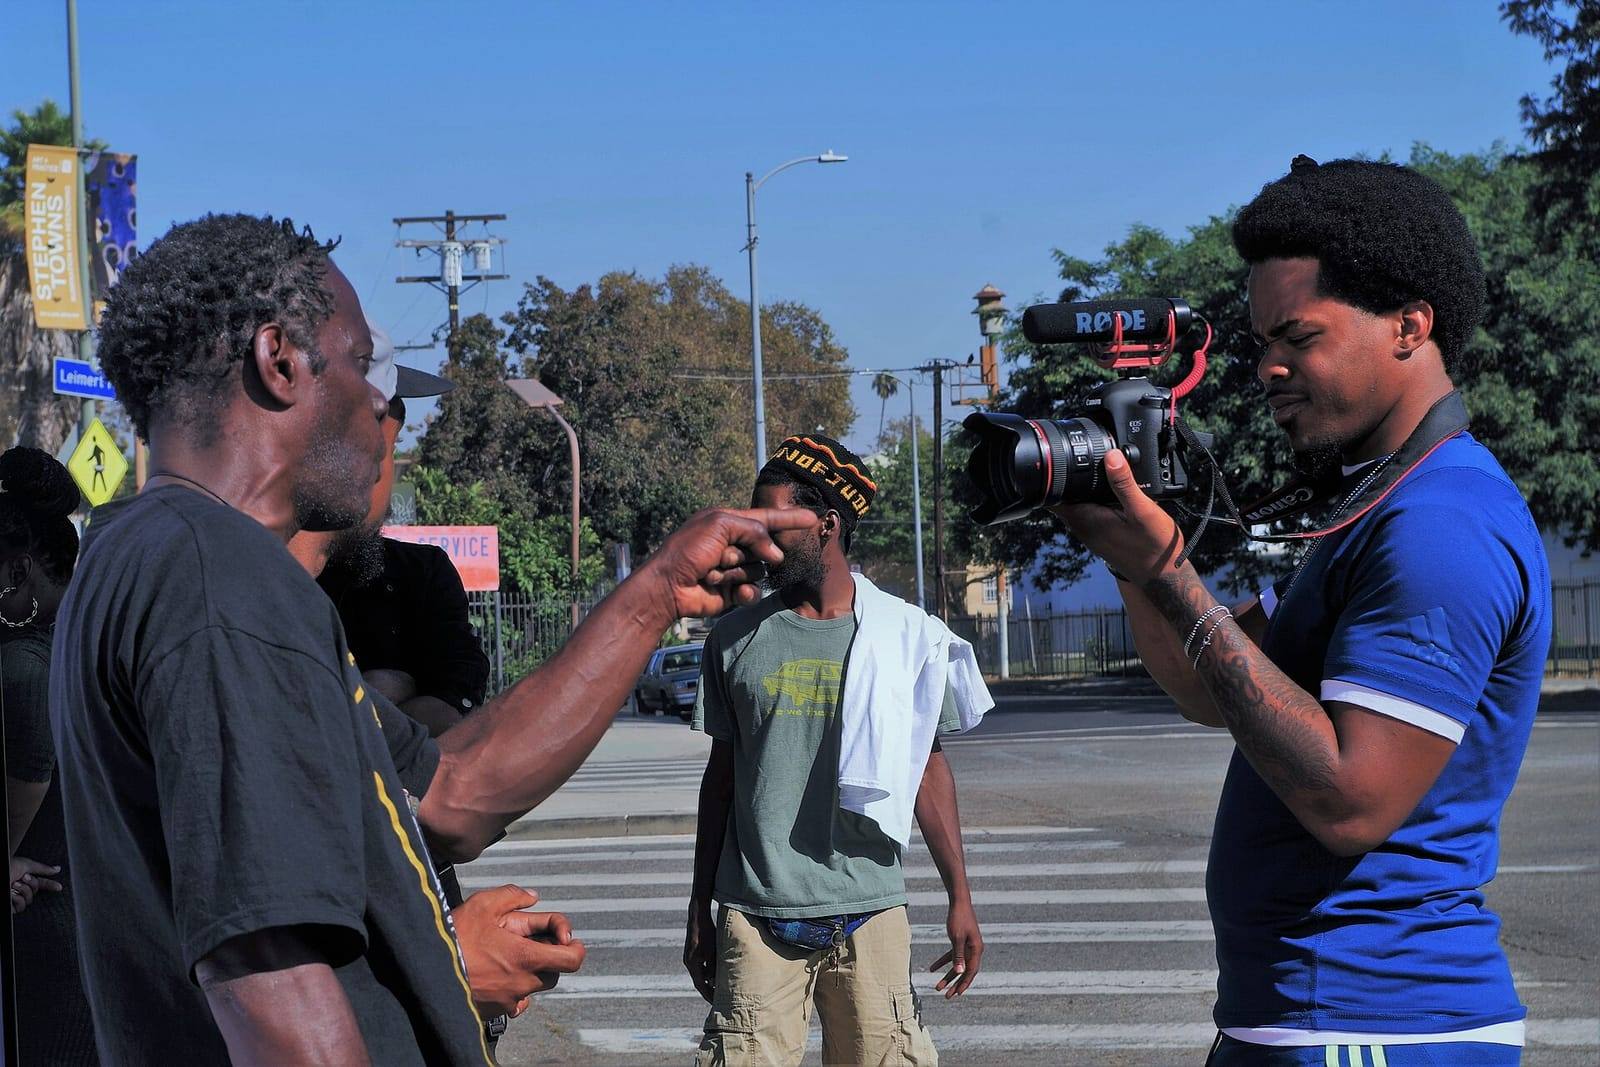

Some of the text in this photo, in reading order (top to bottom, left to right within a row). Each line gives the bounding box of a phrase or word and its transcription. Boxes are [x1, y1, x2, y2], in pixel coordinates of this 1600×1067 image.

[31, 181, 51, 301] STEPHEN
[47, 194, 67, 289] TOWNS
[60, 368, 104, 389] Leimert
[1246, 487, 1314, 520] Canon
